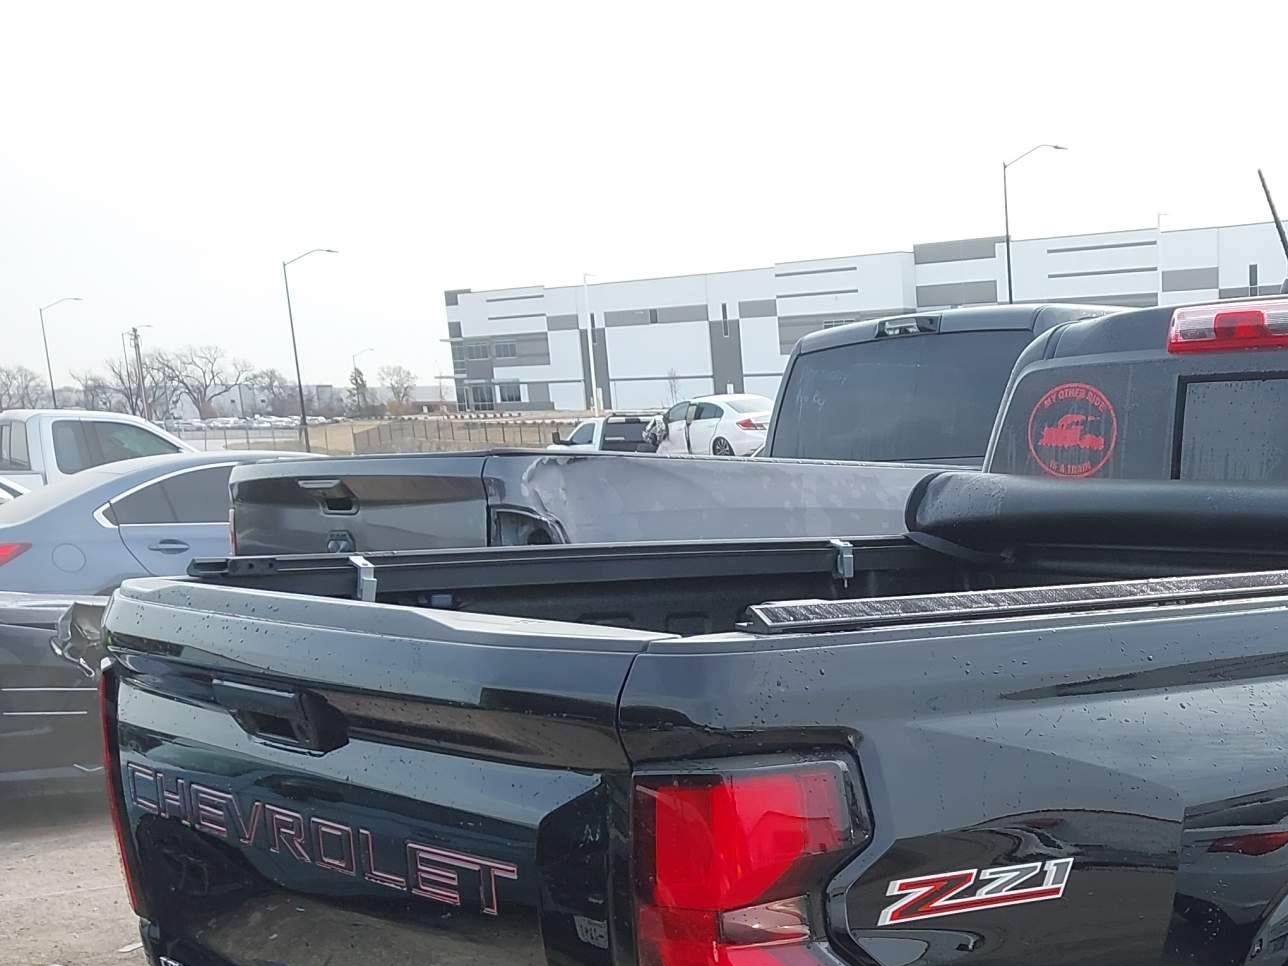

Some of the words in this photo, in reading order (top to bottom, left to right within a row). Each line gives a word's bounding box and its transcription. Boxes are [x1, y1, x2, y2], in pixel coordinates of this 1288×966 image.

[1058, 388, 1086, 399] OTHER
[1086, 391, 1106, 411] RIDE
[127, 762, 518, 916] CHEVROLET
[877, 858, 1074, 926] Z71
